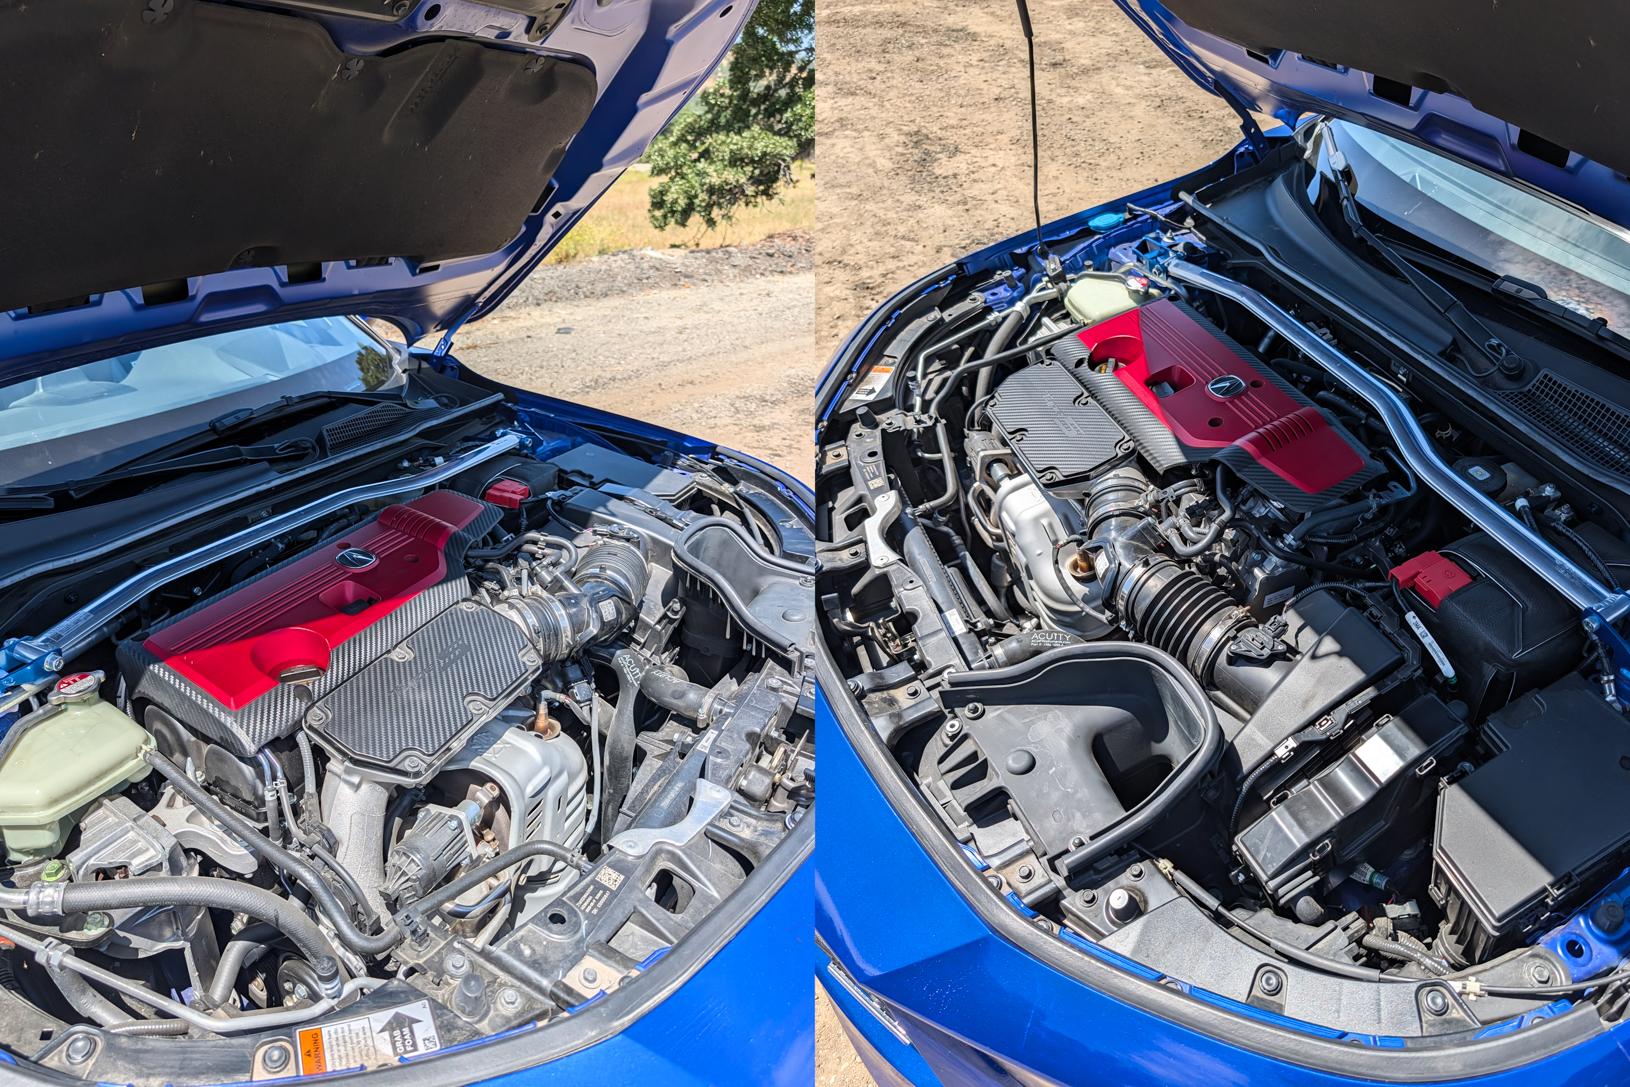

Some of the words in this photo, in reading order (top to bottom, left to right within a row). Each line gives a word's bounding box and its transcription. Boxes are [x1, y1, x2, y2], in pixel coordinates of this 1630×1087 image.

[1031, 632, 1071, 641] ACUITY
[622, 654, 641, 684] ACUIT
[393, 1028, 405, 1054] GRAB
[401, 1026, 414, 1051] FOAM
[311, 1032, 323, 1072] WARNING
